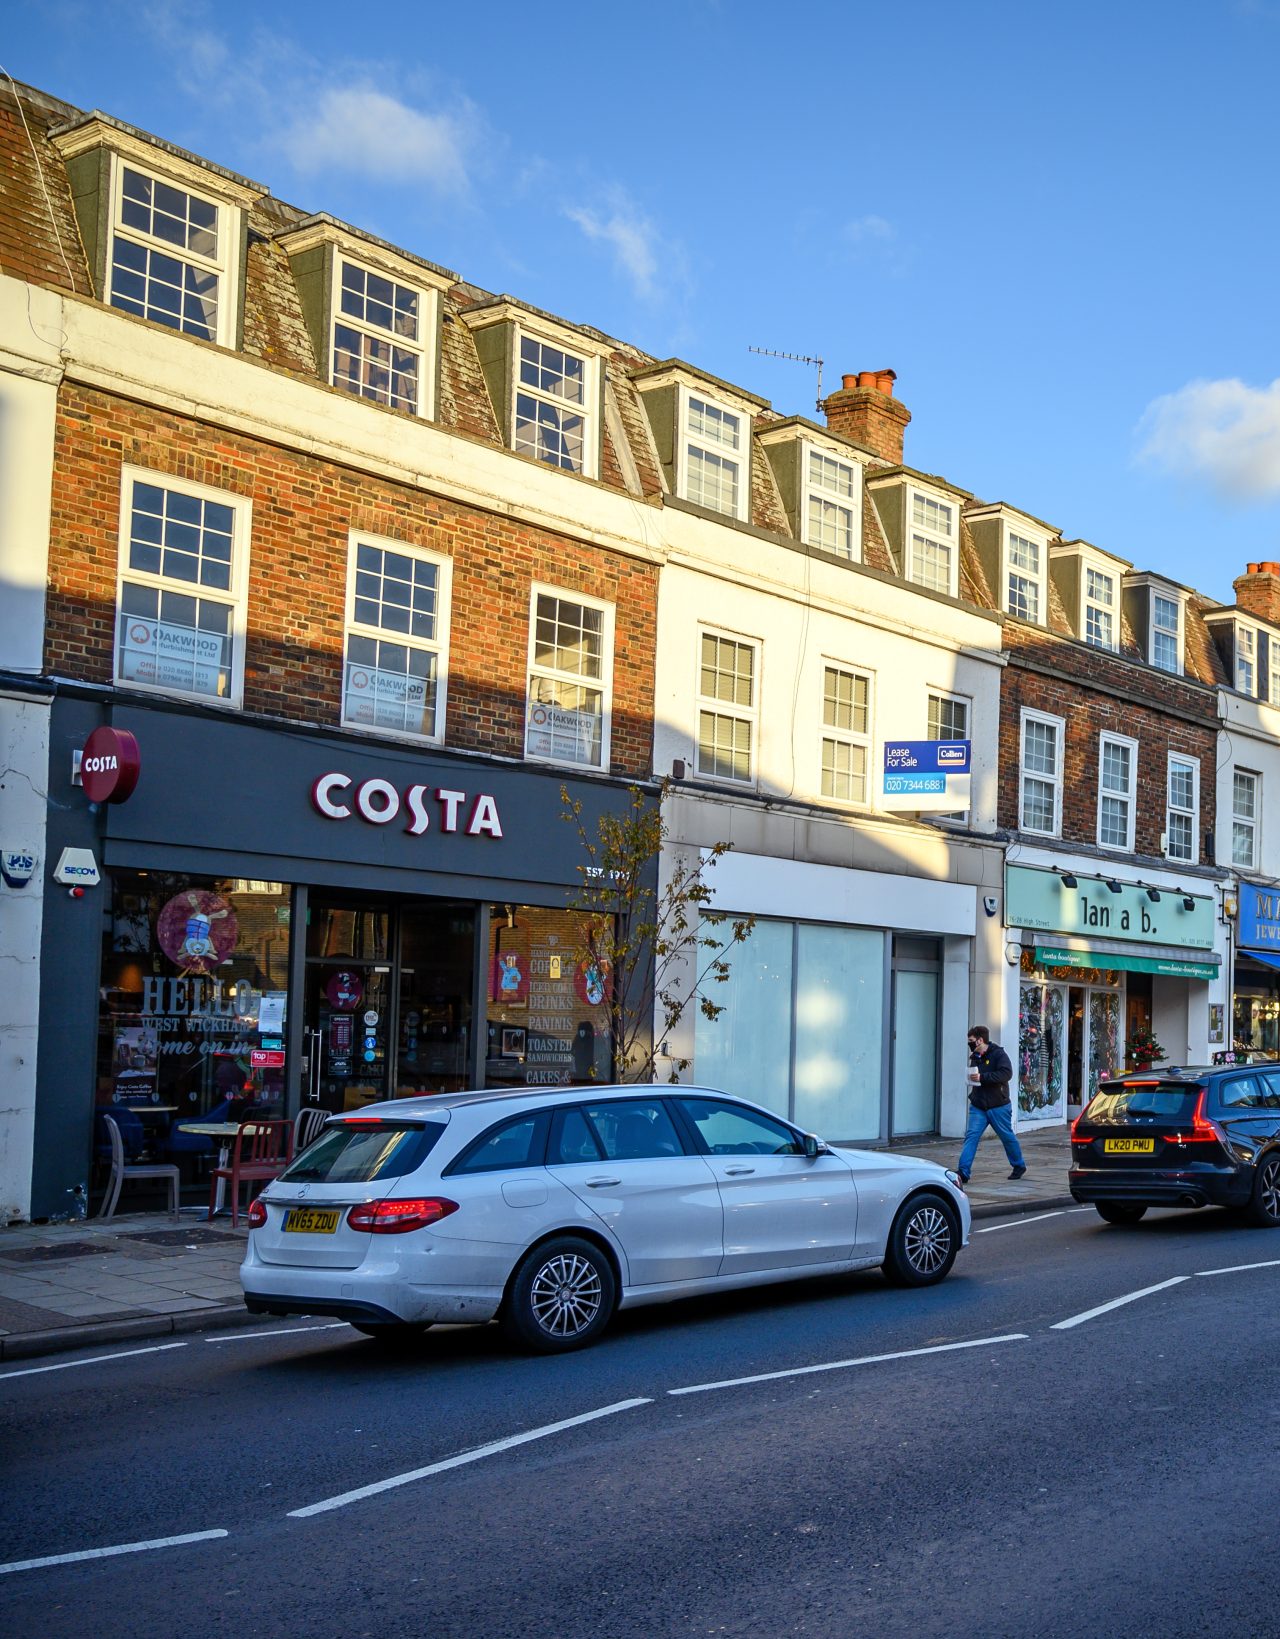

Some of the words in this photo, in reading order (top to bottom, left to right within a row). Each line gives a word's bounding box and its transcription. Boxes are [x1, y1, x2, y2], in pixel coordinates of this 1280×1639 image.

[152, 628, 218, 651] OAKWOOD
[887, 748, 910, 757] Lease
[941, 750, 963, 758] Colliers
[85, 755, 118, 772] COSTA
[887, 757, 900, 767] For
[901, 757, 918, 767] Sale
[886, 780, 901, 790] 020
[903, 780, 923, 791] 7344
[924, 779, 944, 790] 6881
[312, 772, 503, 838] COSTA
[64, 866, 96, 876] SECOM
[530, 960, 575, 975] COFEE
[142, 976, 254, 1017] HELLO
[529, 996, 574, 1010] DRINKS
[141, 1017, 181, 1032] WEST
[528, 1016, 573, 1031] PANINIS
[527, 1038, 573, 1051] TOASTED
[527, 1053, 573, 1062] SANDWICHES
[526, 1070, 561, 1084] CAKES
[1108, 1140, 1130, 1150] LK20
[1132, 1140, 1150, 1150] PMU
[288, 1212, 315, 1229] MV65
[314, 1213, 337, 1230] ZDU
